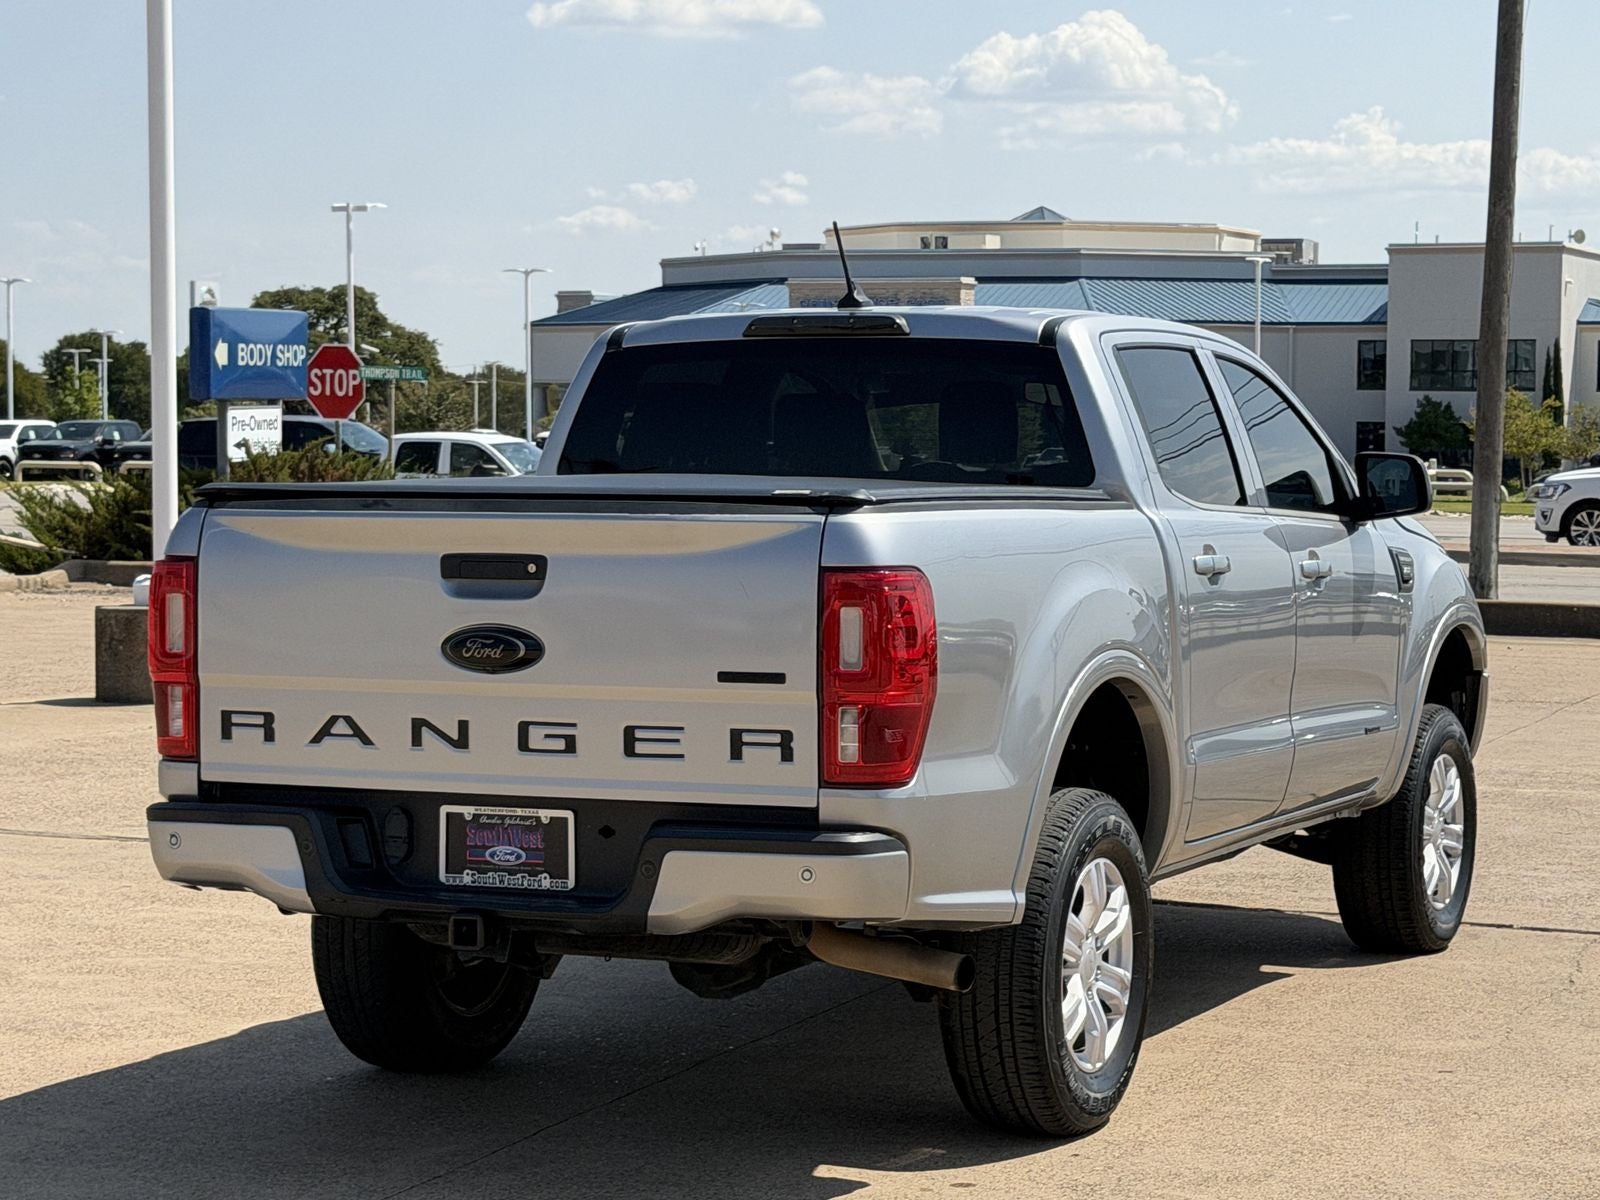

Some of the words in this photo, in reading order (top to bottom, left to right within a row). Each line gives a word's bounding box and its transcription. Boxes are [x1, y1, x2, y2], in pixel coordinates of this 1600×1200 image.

[237, 343, 274, 367] BODY
[276, 344, 307, 367] SHOP
[309, 368, 360, 397] STOP
[361, 367, 400, 379] THOMPSON
[401, 368, 425, 380] TRAIL
[231, 415, 278, 432] Pre-Owned
[462, 638, 505, 658] Ford
[220, 709, 794, 763] RANGER
[494, 849, 517, 862] Ford
